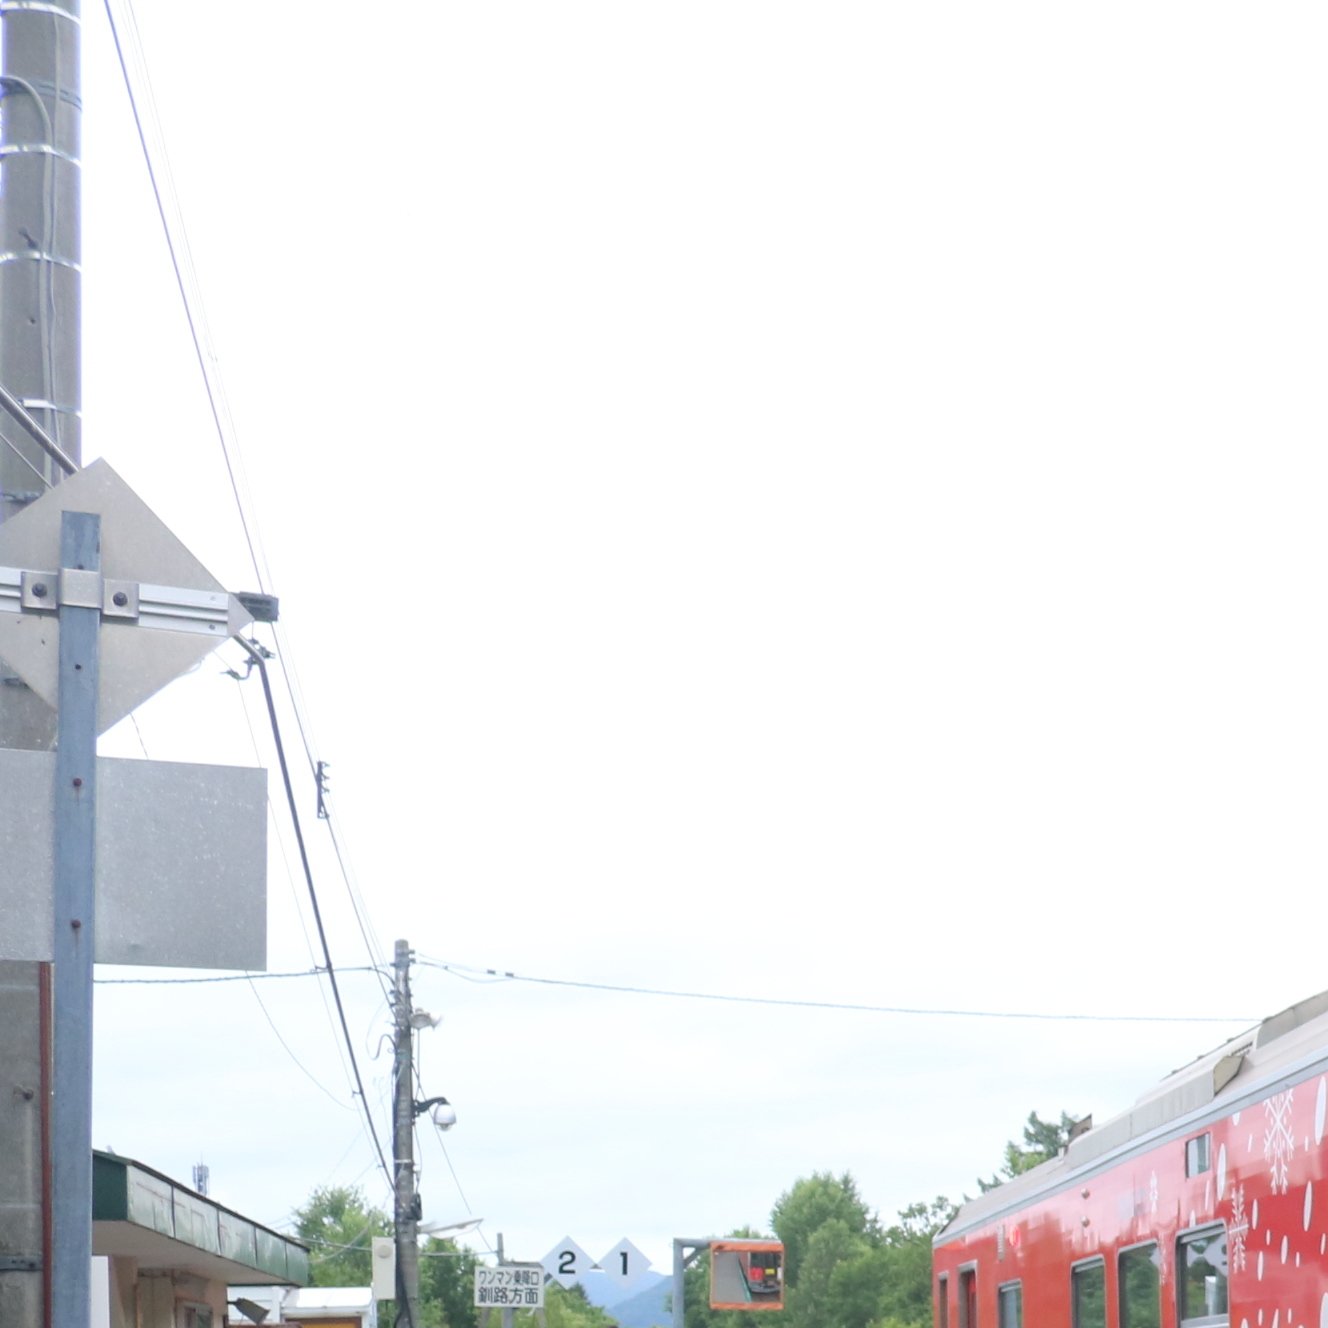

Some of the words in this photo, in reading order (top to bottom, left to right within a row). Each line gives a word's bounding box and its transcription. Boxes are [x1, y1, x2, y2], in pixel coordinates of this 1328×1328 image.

[558, 1250, 576, 1274] 2
[619, 1252, 628, 1275] 1
[478, 1270, 540, 1286] ワンマン乗降口
[478, 1286, 539, 1304] 釧路方面
